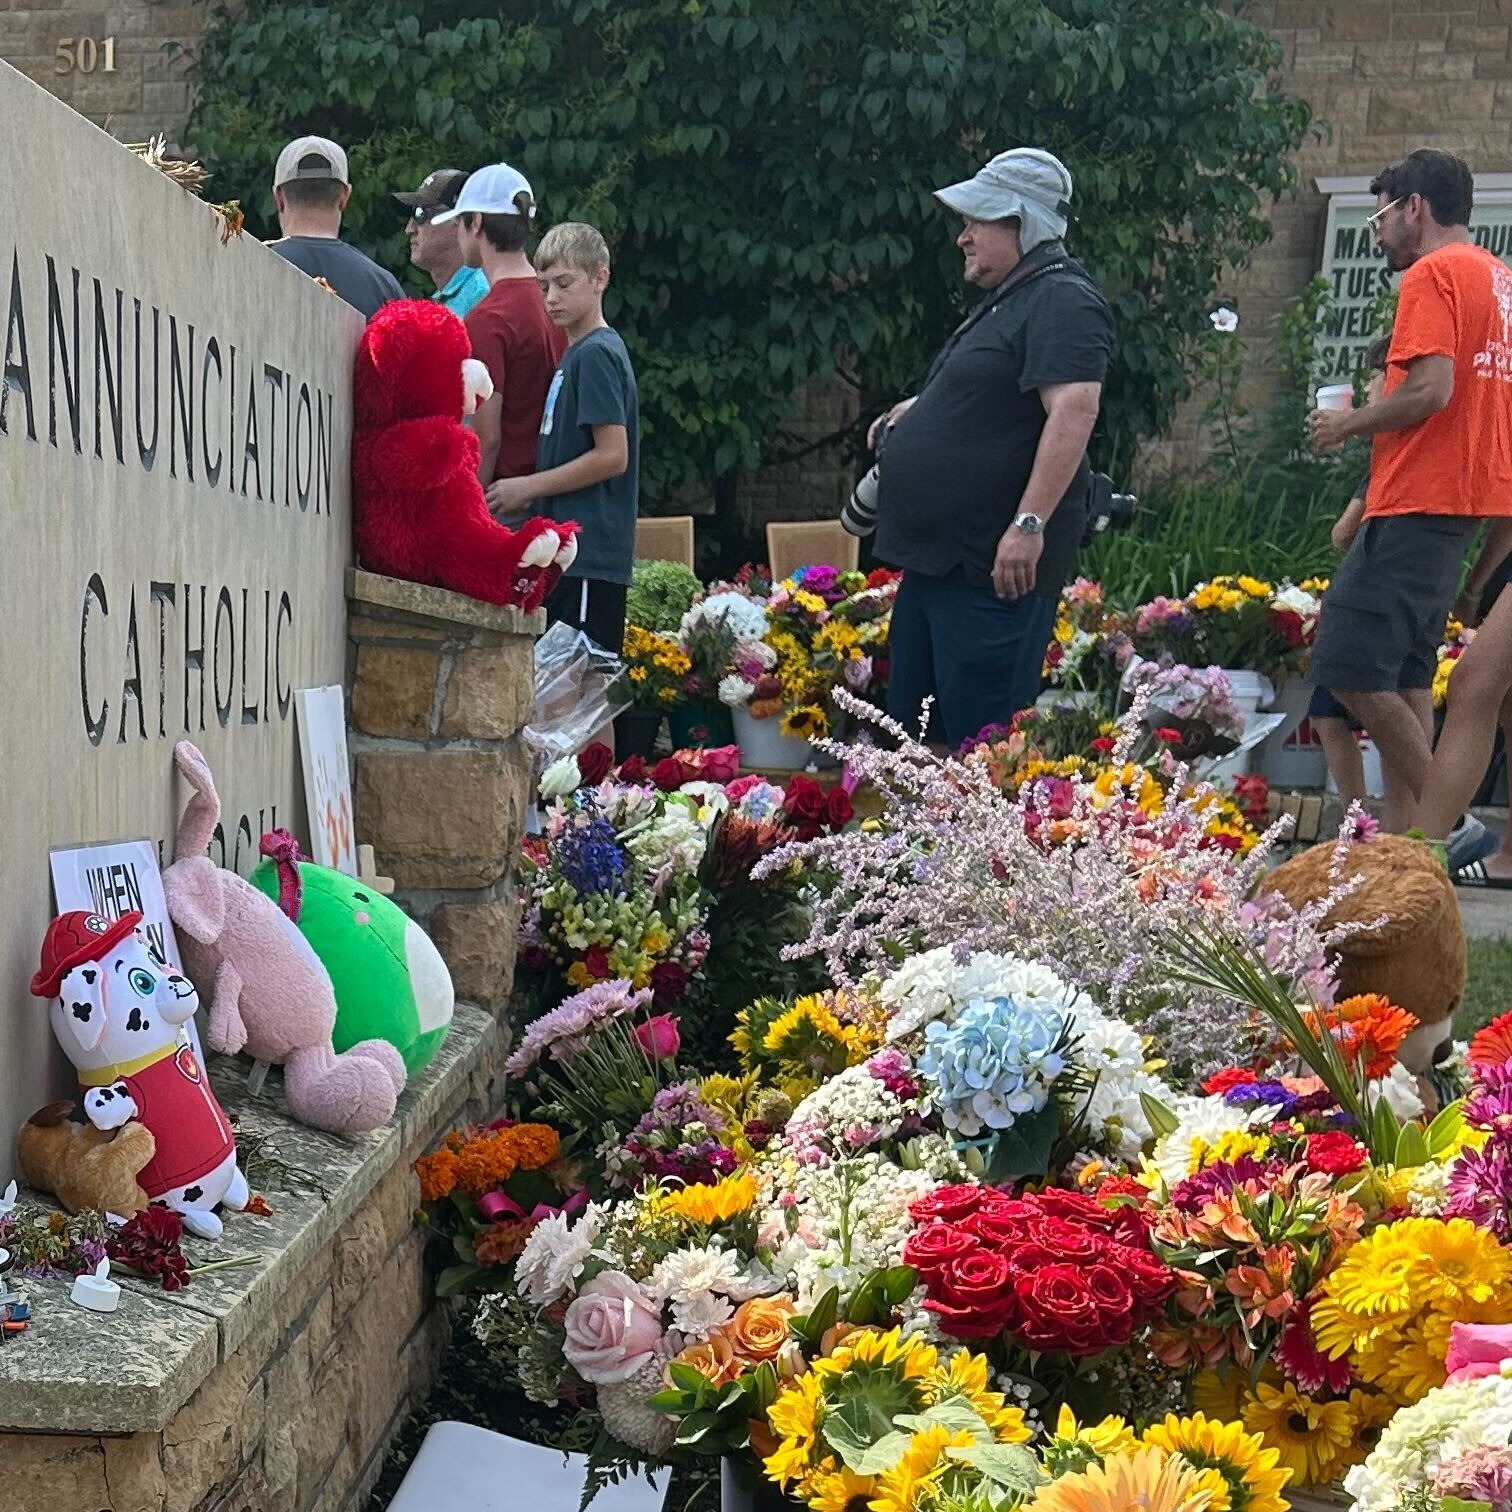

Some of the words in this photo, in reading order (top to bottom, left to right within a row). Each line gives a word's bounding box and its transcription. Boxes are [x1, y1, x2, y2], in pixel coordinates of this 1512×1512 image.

[55, 37, 118, 76] 501
[1332, 266, 1394, 299] TUES
[80, 572, 294, 747] CATHOLIC
[85, 862, 145, 922] WHEN
